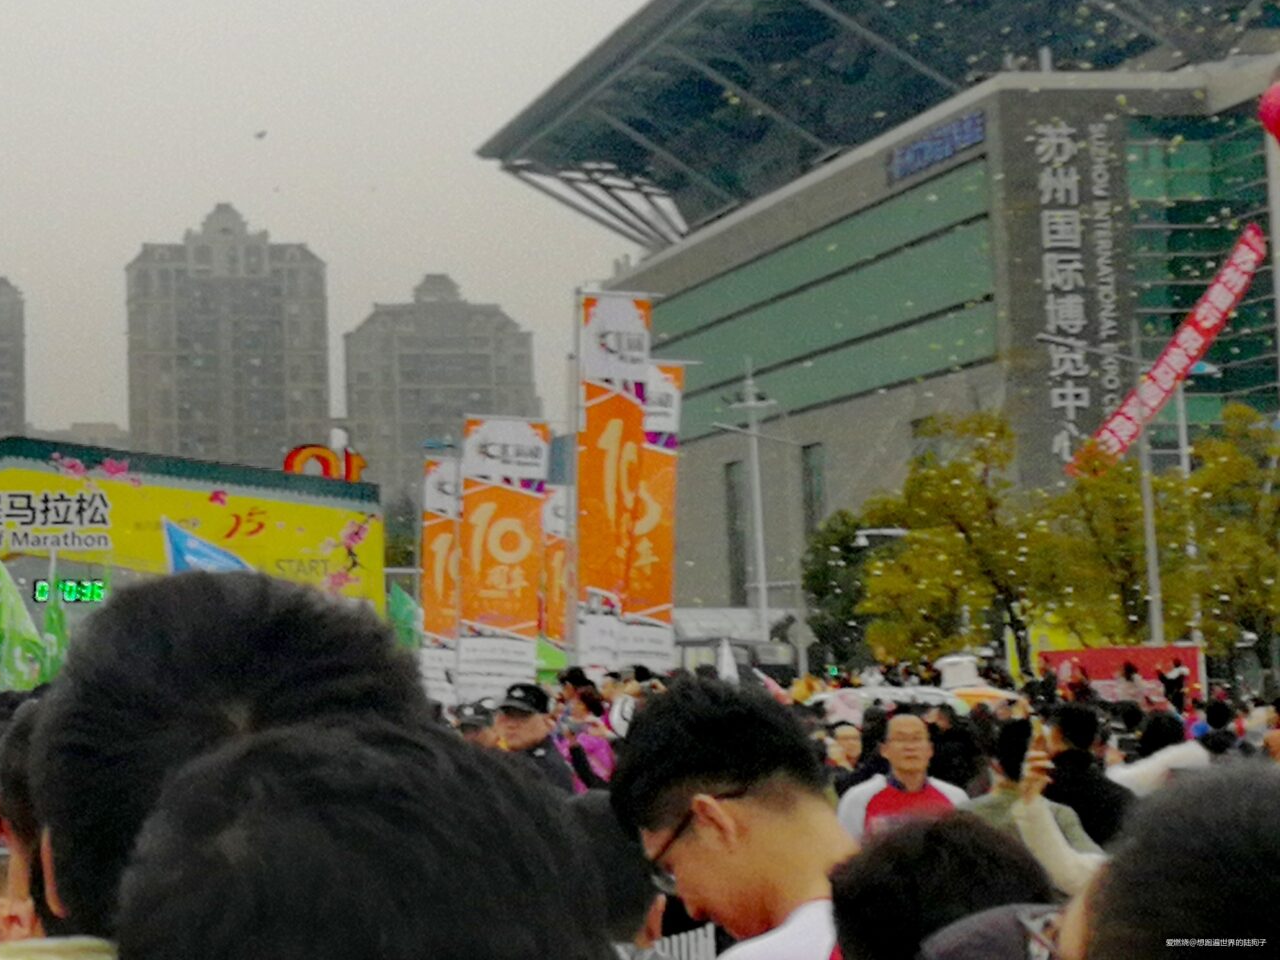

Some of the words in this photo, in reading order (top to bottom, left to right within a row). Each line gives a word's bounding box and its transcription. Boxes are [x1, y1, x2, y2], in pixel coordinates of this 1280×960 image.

[1093, 200, 1119, 339] INTERNATIONAL
[12, 531, 109, 548] Marathon
[467, 502, 532, 576] 10
